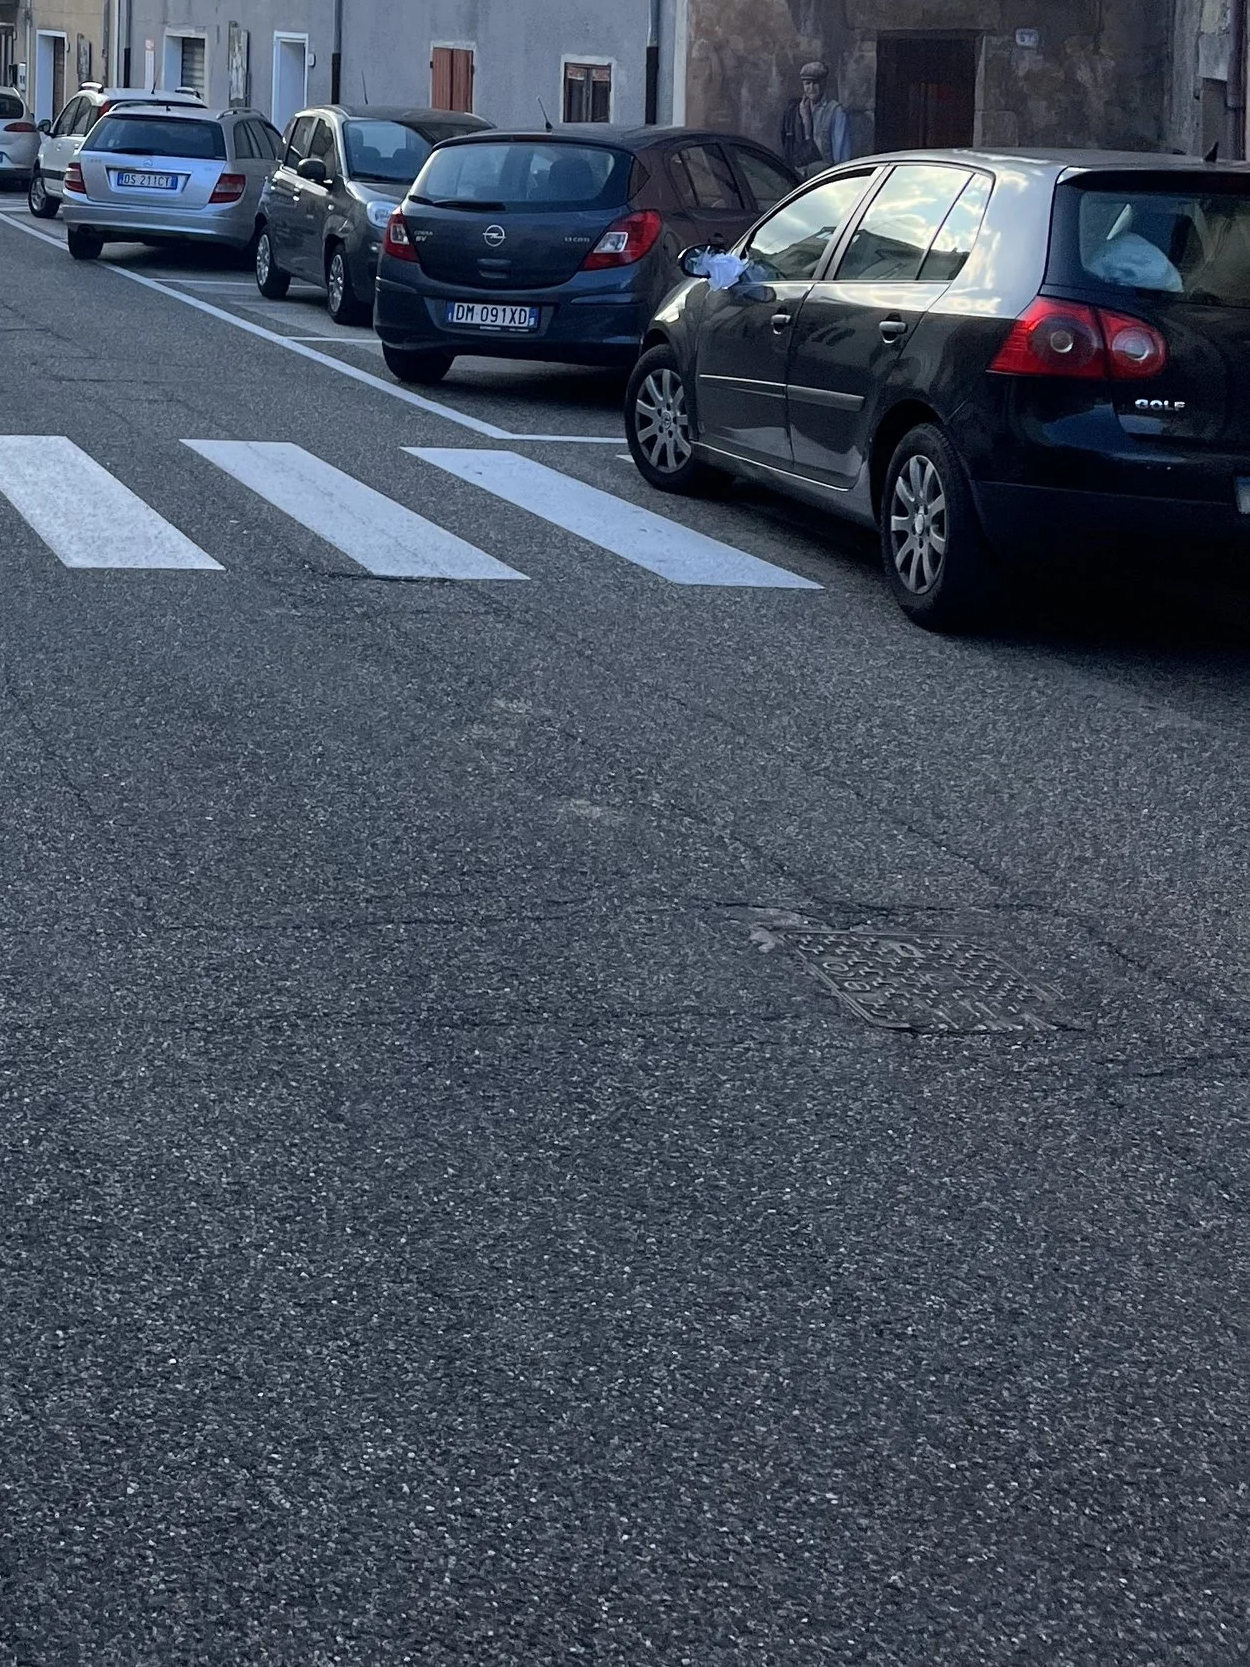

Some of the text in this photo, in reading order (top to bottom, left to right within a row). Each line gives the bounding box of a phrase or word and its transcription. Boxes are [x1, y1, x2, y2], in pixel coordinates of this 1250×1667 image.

[123, 174, 137, 185] DS
[455, 304, 475, 321] DM
[480, 306, 528, 325] 091XD
[1134, 398, 1186, 412] GOLF
